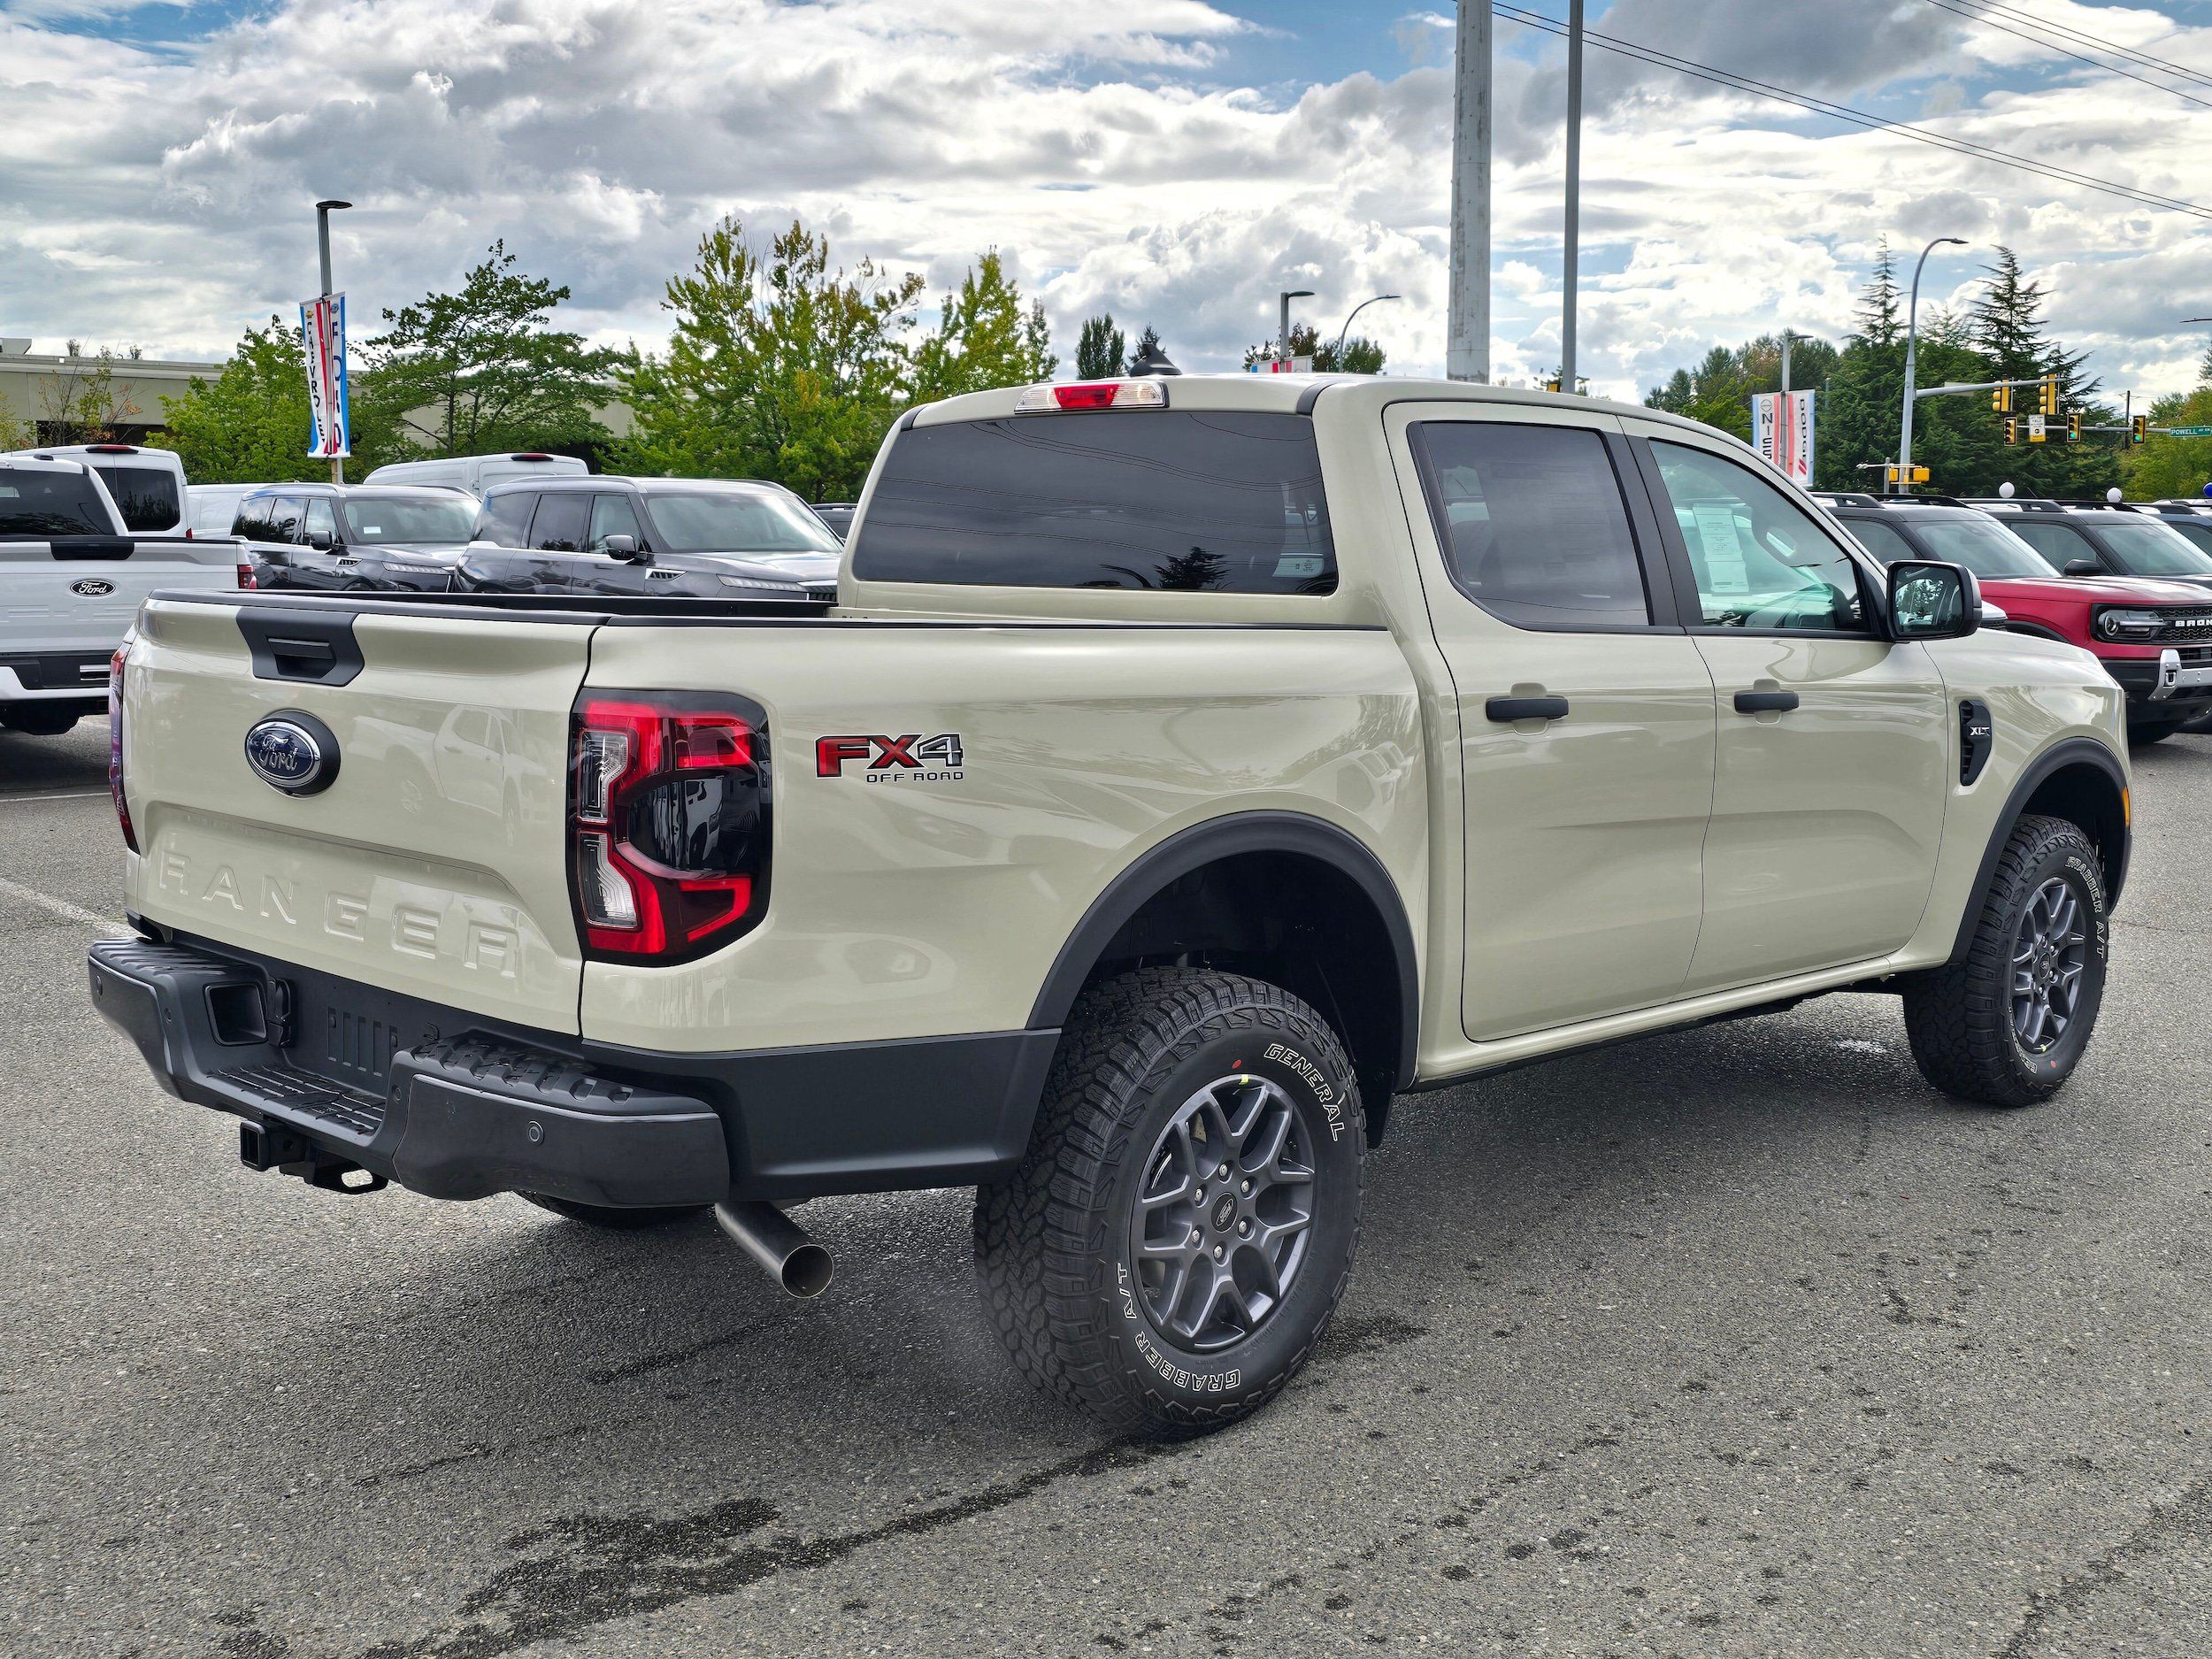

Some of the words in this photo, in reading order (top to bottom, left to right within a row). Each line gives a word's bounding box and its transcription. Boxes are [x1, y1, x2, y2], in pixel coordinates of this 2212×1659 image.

[78, 581, 107, 594] Ford
[258, 733, 299, 772] Ford
[814, 733, 964, 779] FX4
[1970, 726, 1990, 736] XLT
[866, 773, 906, 784] OFF
[912, 771, 964, 781] ROAD
[158, 849, 521, 978] RANGER
[2064, 856, 2103, 913] GRABBER
[2095, 920, 2106, 959] A/T
[1263, 1043, 1346, 1142] GENERAL
[1118, 1262, 1137, 1319] A/T
[1134, 1330, 1240, 1392] GRABBER
